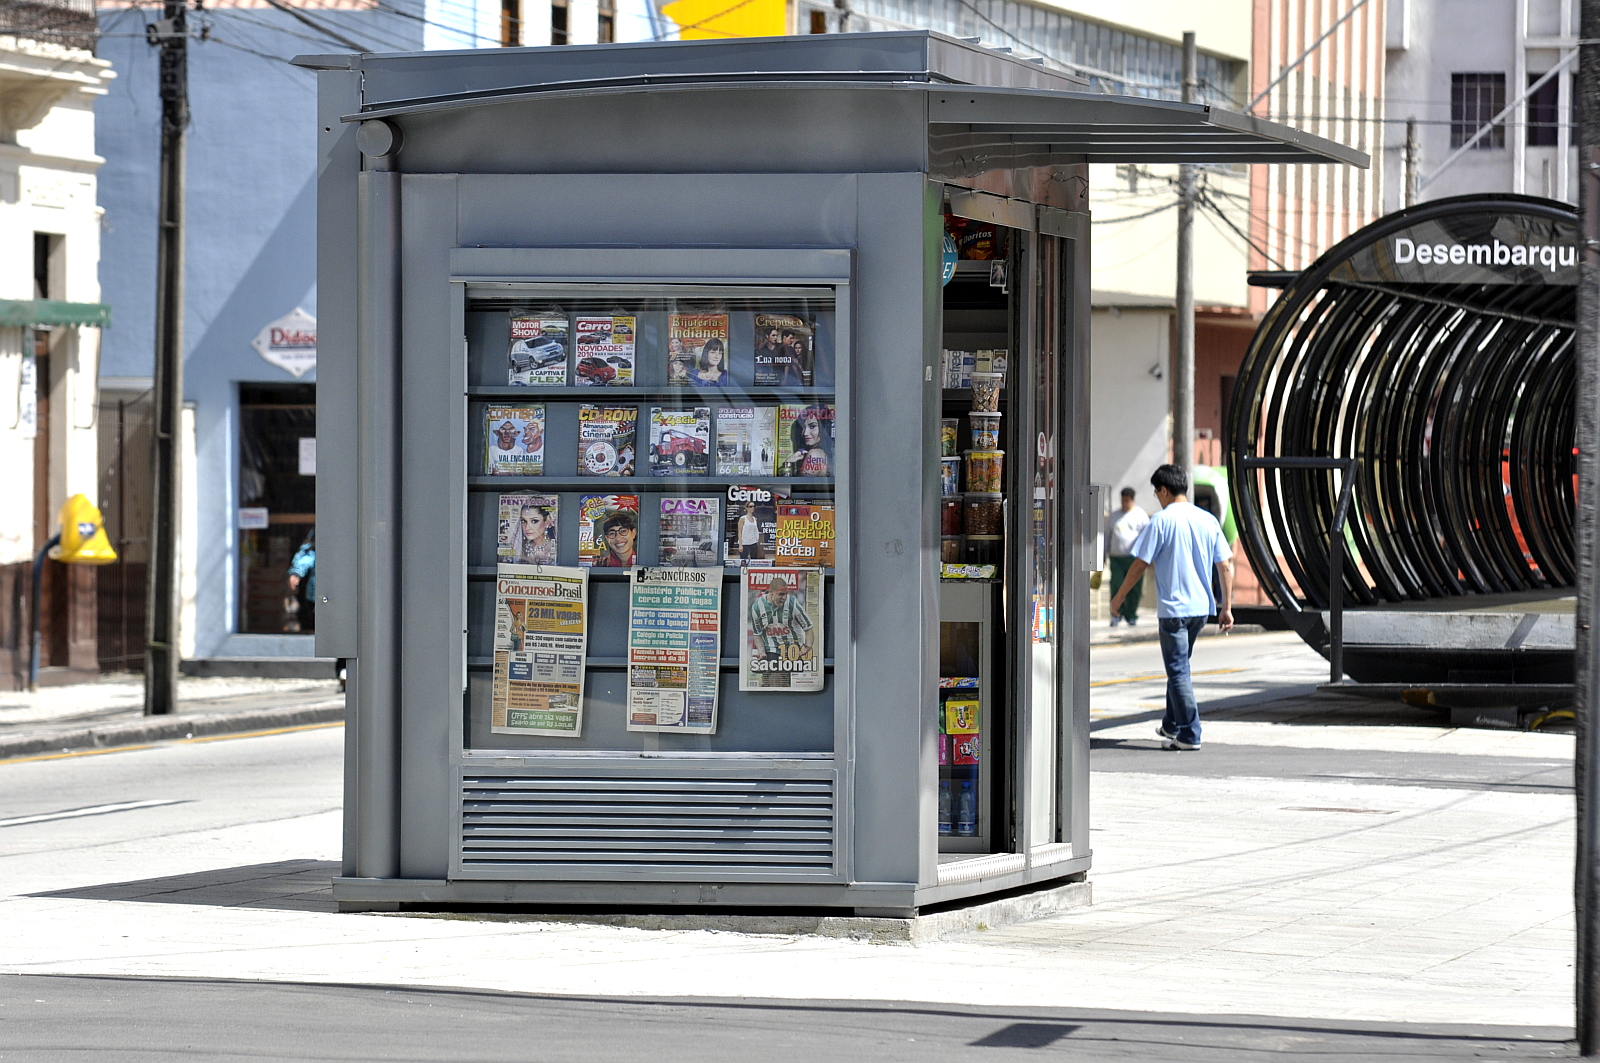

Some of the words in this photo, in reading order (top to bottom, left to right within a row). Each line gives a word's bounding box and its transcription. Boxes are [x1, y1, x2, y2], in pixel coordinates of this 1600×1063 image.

[963, 231, 992, 244] Doritos
[1395, 238, 1578, 272] Desembarqu
[512, 321, 539, 329] MOTOR
[577, 321, 611, 331] Carro
[672, 316, 724, 328] Bijuterias
[670, 327, 726, 338] Indianas
[669, 352, 677, 360] 7
[755, 355, 772, 364] Lua
[774, 356, 792, 364] nova
[949, 351, 961, 372] free
[578, 409, 638, 421] CD-ROM
[780, 405, 835, 419] atrevida
[582, 430, 611, 438] Cinema
[498, 454, 508, 462] VAI
[510, 454, 541, 462] ENCARAR?
[806, 455, 828, 464] demi
[720, 466, 731, 474] 66
[738, 465, 750, 474] 54
[728, 485, 771, 502] Gente
[661, 500, 709, 514] CASA
[810, 511, 820, 522] O
[783, 519, 831, 531] MELHOR
[595, 534, 603, 545] é
[776, 528, 835, 540] CONSELHO
[579, 541, 607, 551] BELA
[778, 537, 802, 547] QUE
[776, 546, 815, 557] RECEBI
[633, 585, 672, 595] Ministério
[675, 587, 717, 596] Público-PR:
[638, 596, 660, 604] cerca
[674, 596, 689, 604] 200
[691, 597, 713, 606] vagas
[528, 607, 540, 618] 23
[540, 608, 555, 619] MIL
[556, 609, 582, 621] vagas
[633, 610, 655, 618] Aberto
[657, 611, 688, 619] concurso
[666, 619, 688, 627] Iguaçu
[636, 631, 656, 639] Colégio
[750, 656, 817, 672] sacional
